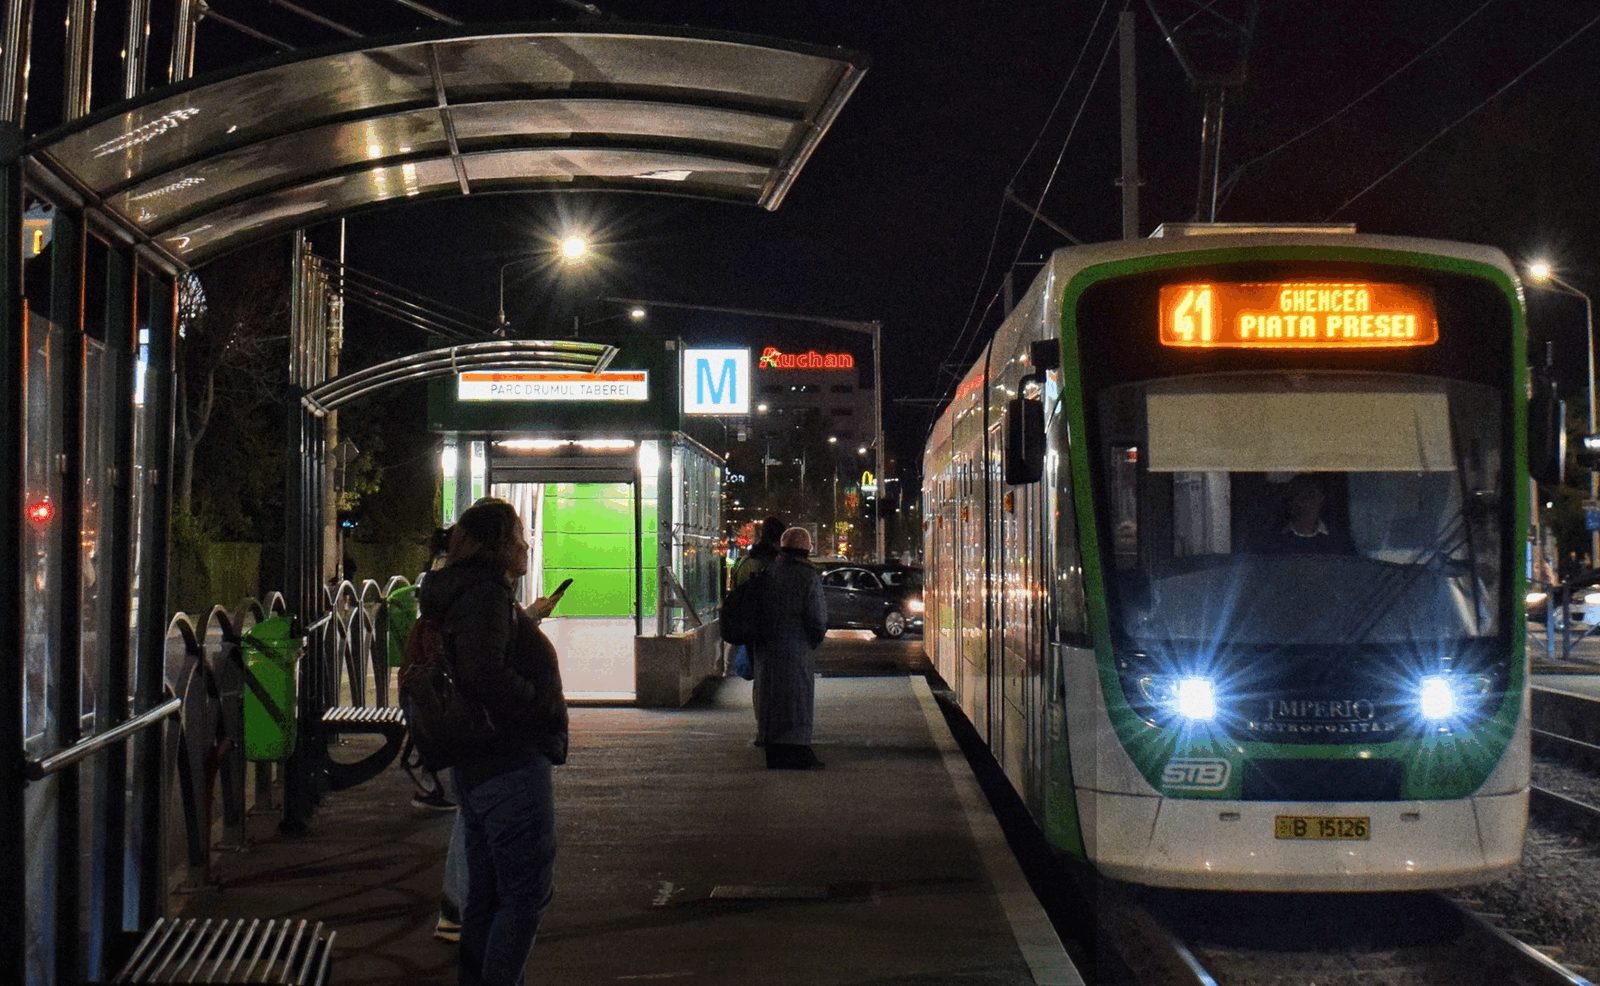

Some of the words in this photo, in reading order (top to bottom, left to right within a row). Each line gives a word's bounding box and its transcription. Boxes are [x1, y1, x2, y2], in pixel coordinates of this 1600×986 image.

[1173, 289, 1212, 341] 41
[1240, 314, 1316, 338] PIATA
[1325, 314, 1416, 338] PRESEI
[758, 347, 854, 369] Auchan
[490, 384, 522, 396] PARC
[525, 384, 575, 396] DRUMUL
[580, 384, 629, 396] TABEREI
[696, 358, 737, 405] M
[1267, 699, 1375, 721] IMPERIO
[1161, 762, 1225, 785] STB
[1293, 819, 1307, 837] B
[1318, 819, 1367, 837] 15126
